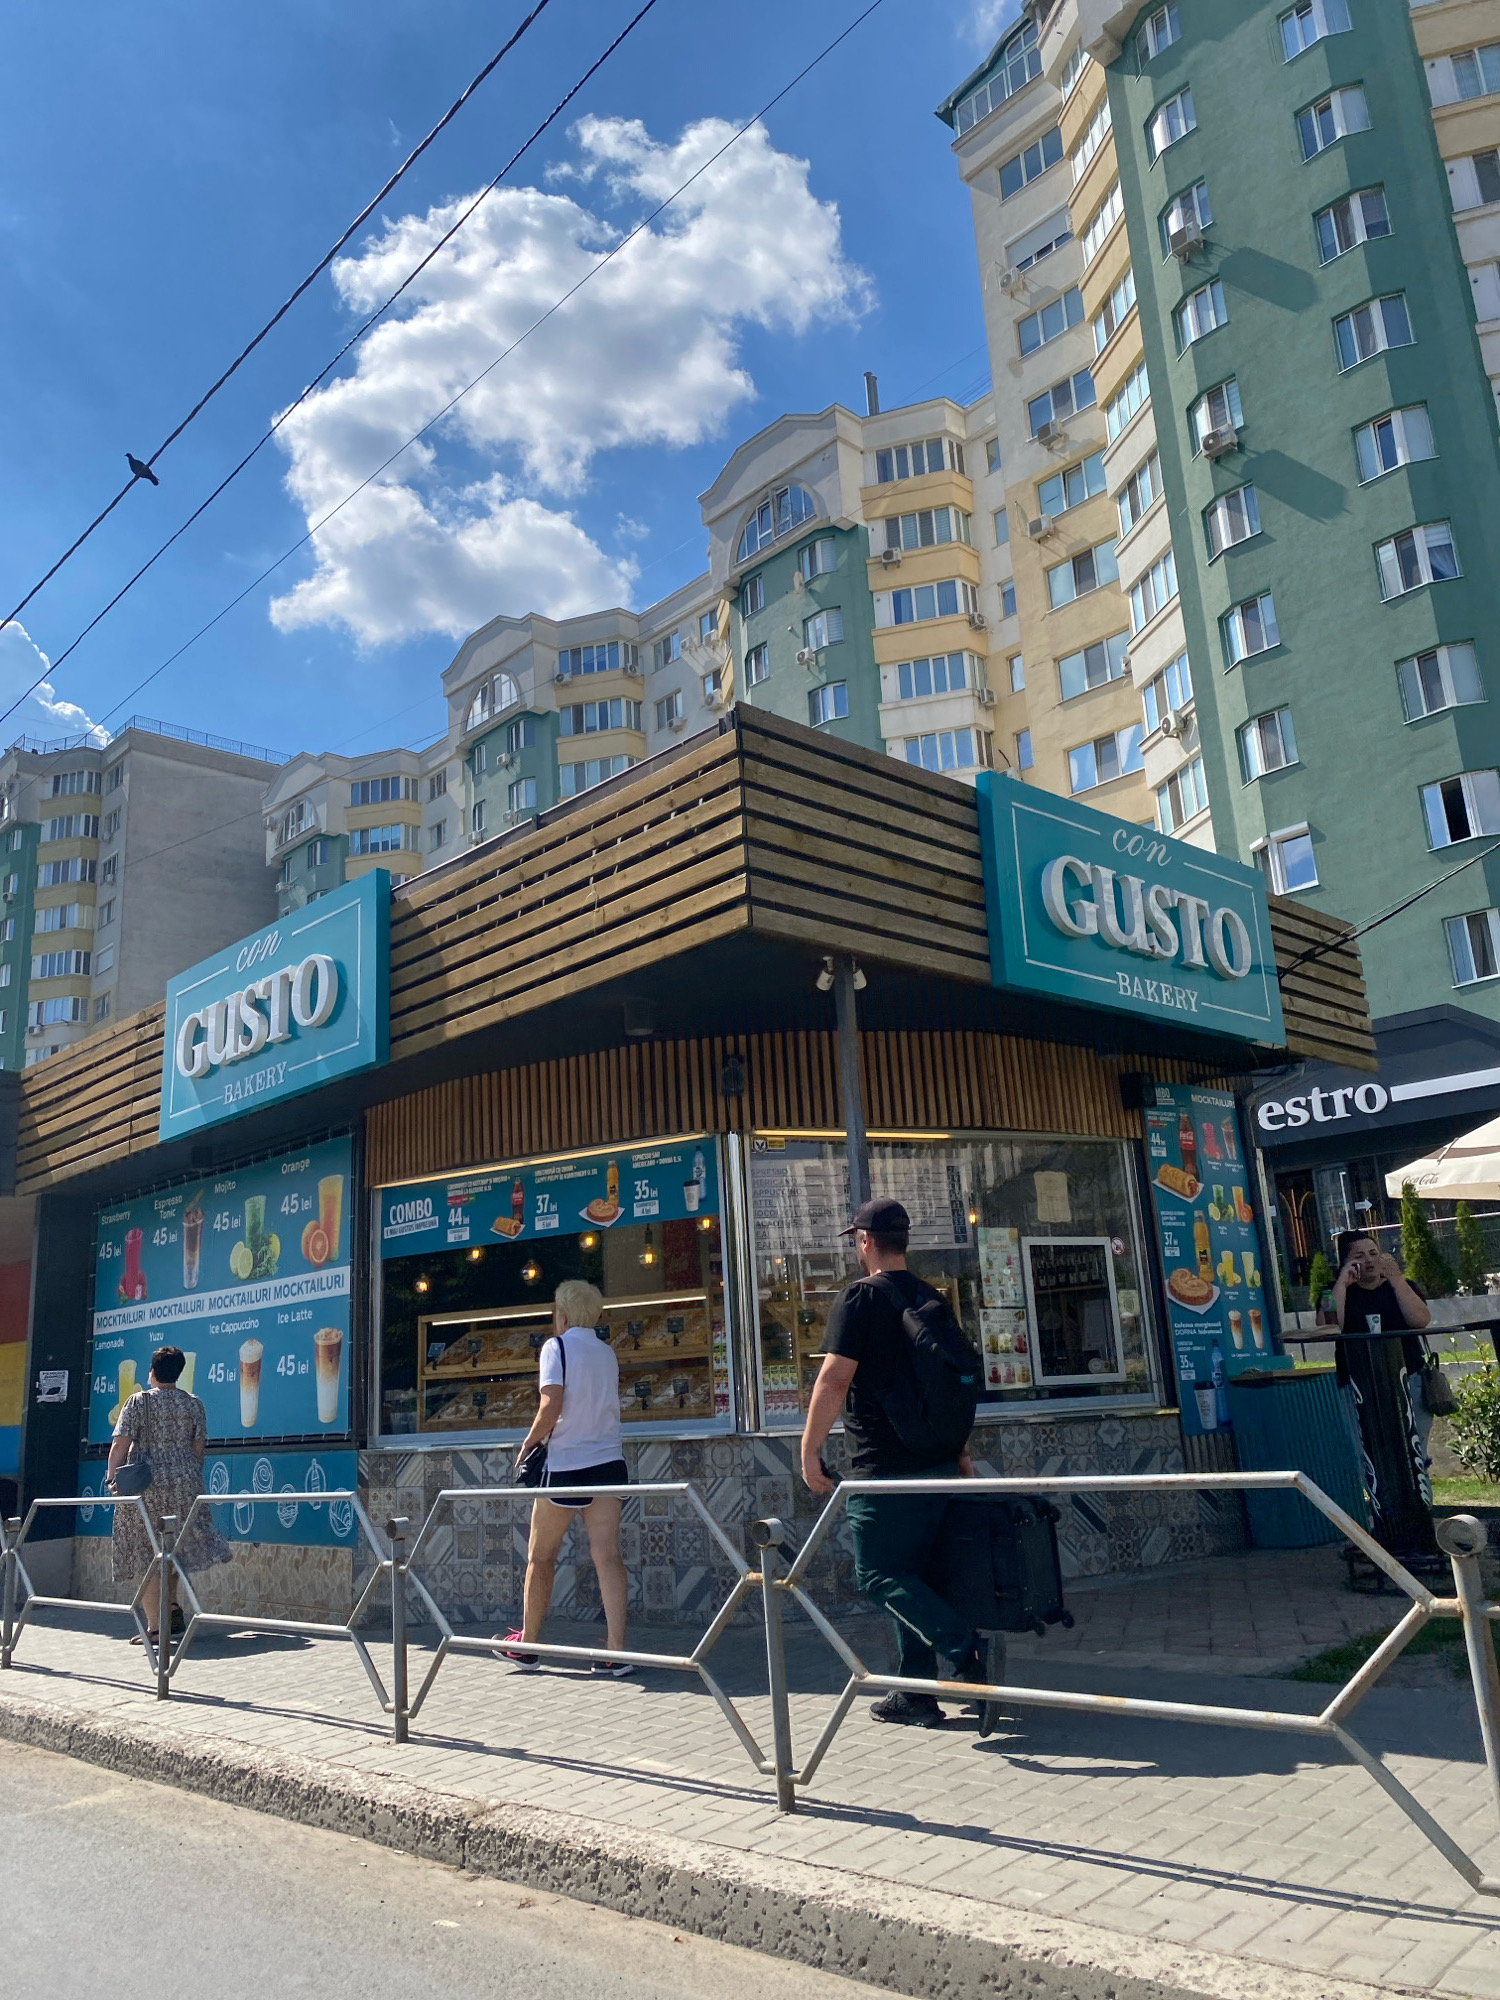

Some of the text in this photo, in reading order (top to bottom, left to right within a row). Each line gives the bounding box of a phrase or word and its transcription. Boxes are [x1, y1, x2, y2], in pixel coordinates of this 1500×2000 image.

[1112, 828, 1172, 867] con
[1041, 855, 1252, 980] GUSTO
[236, 930, 283, 973] con
[1116, 971, 1199, 1012] BAKERY
[176, 953, 339, 1078] GUSTO
[223, 1060, 287, 1105] BAKERY
[1155, 1088, 1170, 1099] MBO
[1257, 1083, 1389, 1131] estro
[1151, 1133, 1161, 1145] 44
[281, 1158, 311, 1175] Orange
[214, 1180, 236, 1194] Mojito
[634, 1179, 658, 1200] 35 lei
[753, 1177, 797, 1186] MERICANO
[754, 1188, 802, 1197] APPUCCINO
[154, 1194, 183, 1211] Espresso
[281, 1193, 313, 1216] 45 lei
[389, 1197, 433, 1225] COMBO
[536, 1193, 550, 1214] 37
[549, 1201, 558, 1212] lei
[101, 1209, 131, 1226] Strawberry
[159, 1207, 177, 1220] Tonic
[213, 1211, 241, 1232] 45 lei
[448, 1207, 470, 1226] 44 lei
[152, 1227, 178, 1247] 45 lei
[1163, 1231, 1173, 1246] 37
[99, 1241, 122, 1260] 45 lei
[96, 1274, 345, 1329] MOCKTAILURI MOCKTAILURI MOCKTAILURI MOCKTAILURI
[209, 1317, 260, 1335] Ice Cappuccino
[277, 1309, 313, 1325] Ice Latte
[149, 1331, 164, 1342] Yuzu
[1174, 1328, 1197, 1336] DORNA
[94, 1337, 125, 1350] Lemonade
[276, 1354, 309, 1376] 45 lei
[1179, 1354, 1189, 1369] 35
[207, 1362, 237, 1384] 45 lei
[93, 1375, 116, 1394] 45 lei
